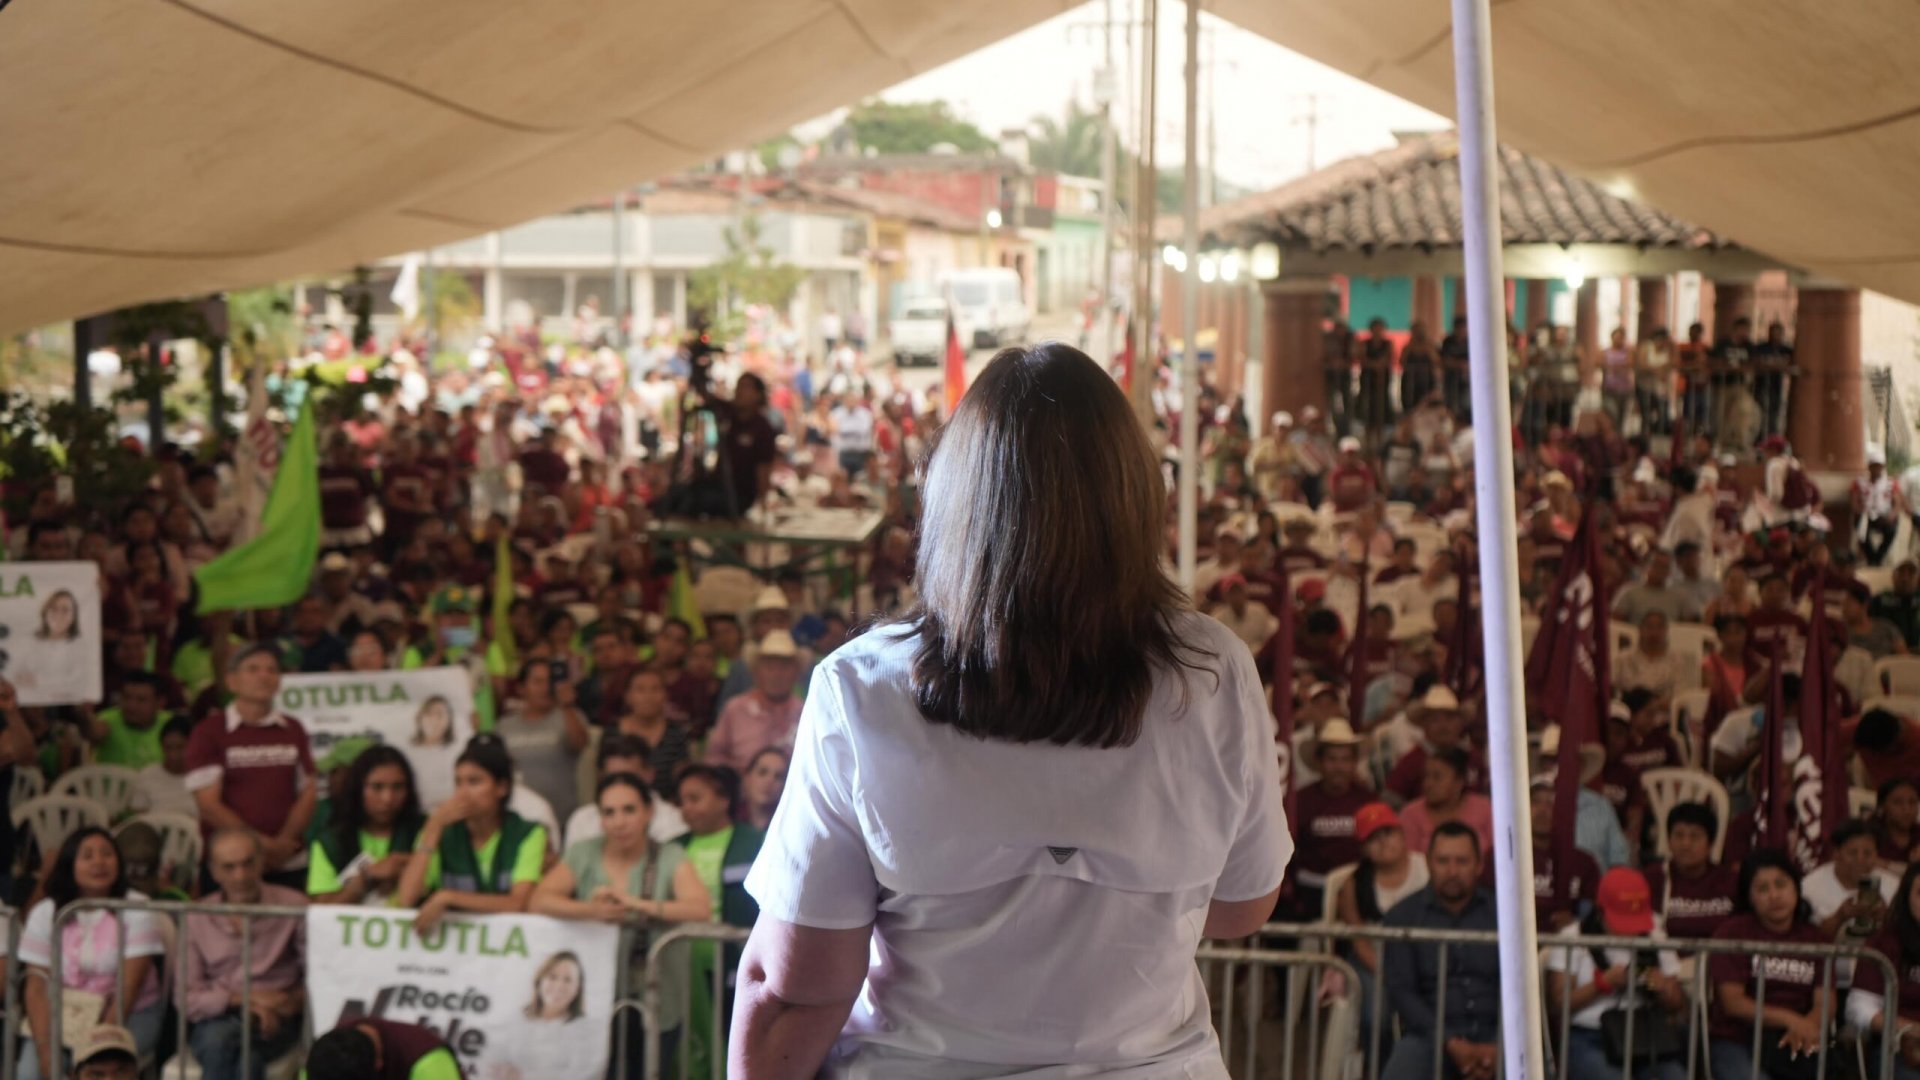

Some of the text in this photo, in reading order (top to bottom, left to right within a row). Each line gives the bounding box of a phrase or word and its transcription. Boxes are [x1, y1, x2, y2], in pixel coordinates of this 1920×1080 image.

[280, 682, 409, 710] OTUTLA
[337, 915, 528, 957] TOTUTLA
[396, 983, 490, 1013] Rocío
